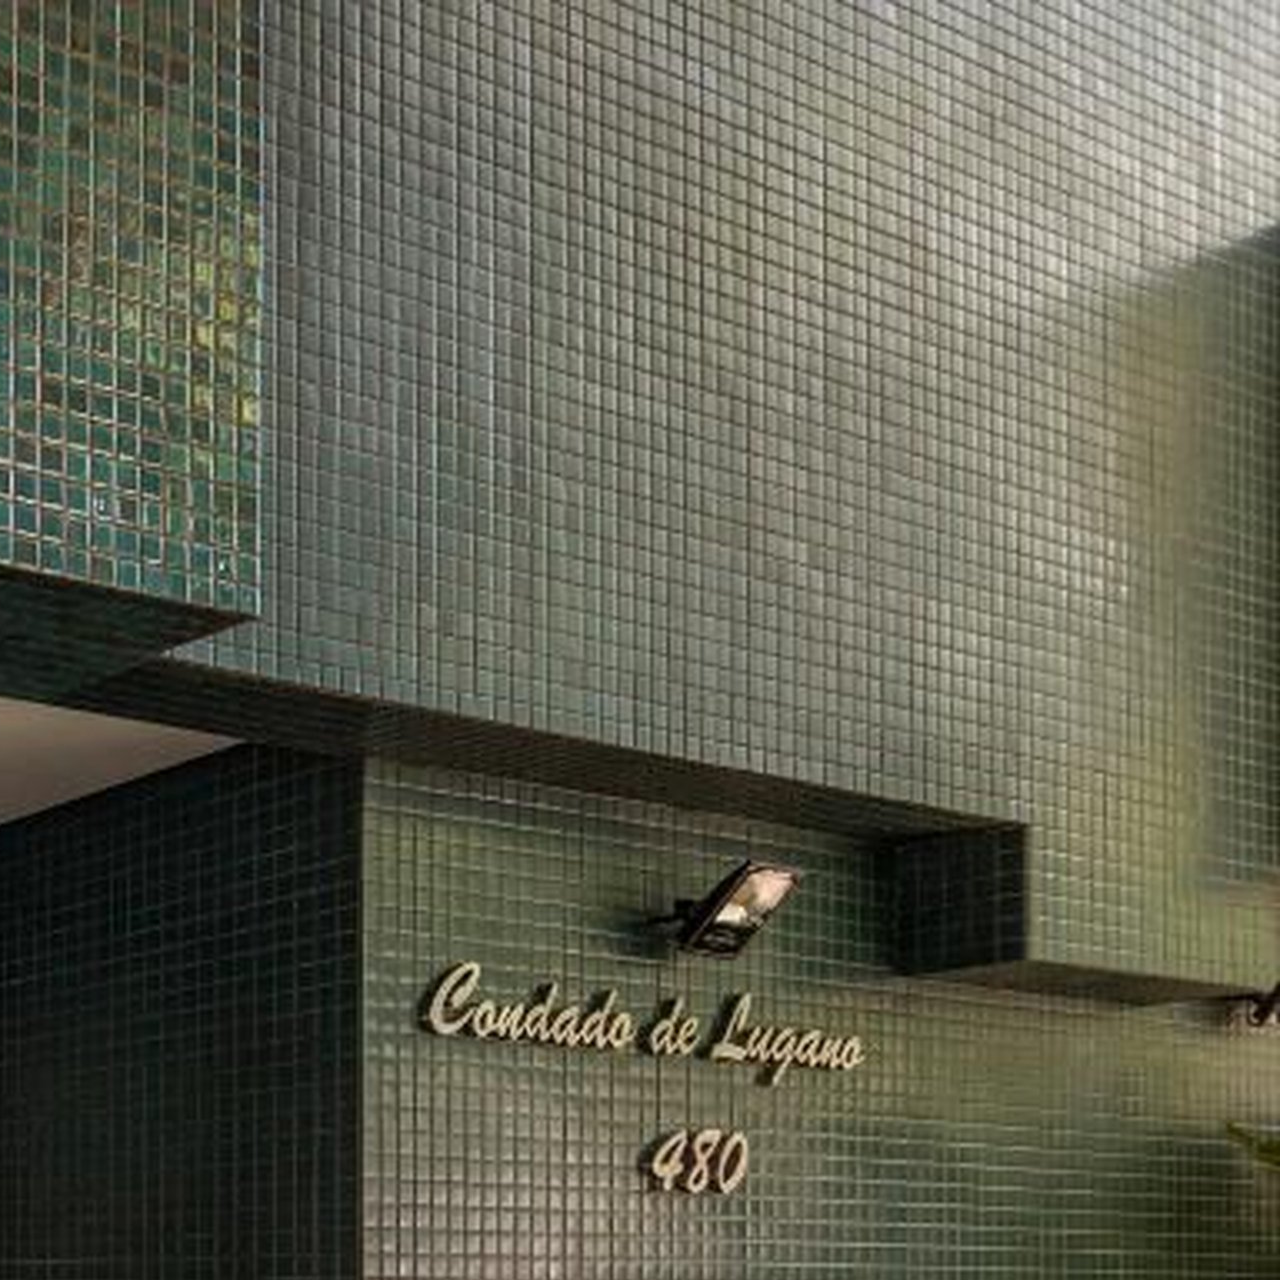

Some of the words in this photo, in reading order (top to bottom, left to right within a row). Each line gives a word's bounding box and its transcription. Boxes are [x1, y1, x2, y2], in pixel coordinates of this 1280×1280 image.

[427, 961, 636, 1050] Condado
[651, 998, 699, 1056] de
[711, 993, 866, 1086] Lugano
[651, 1128, 749, 1195] 480
